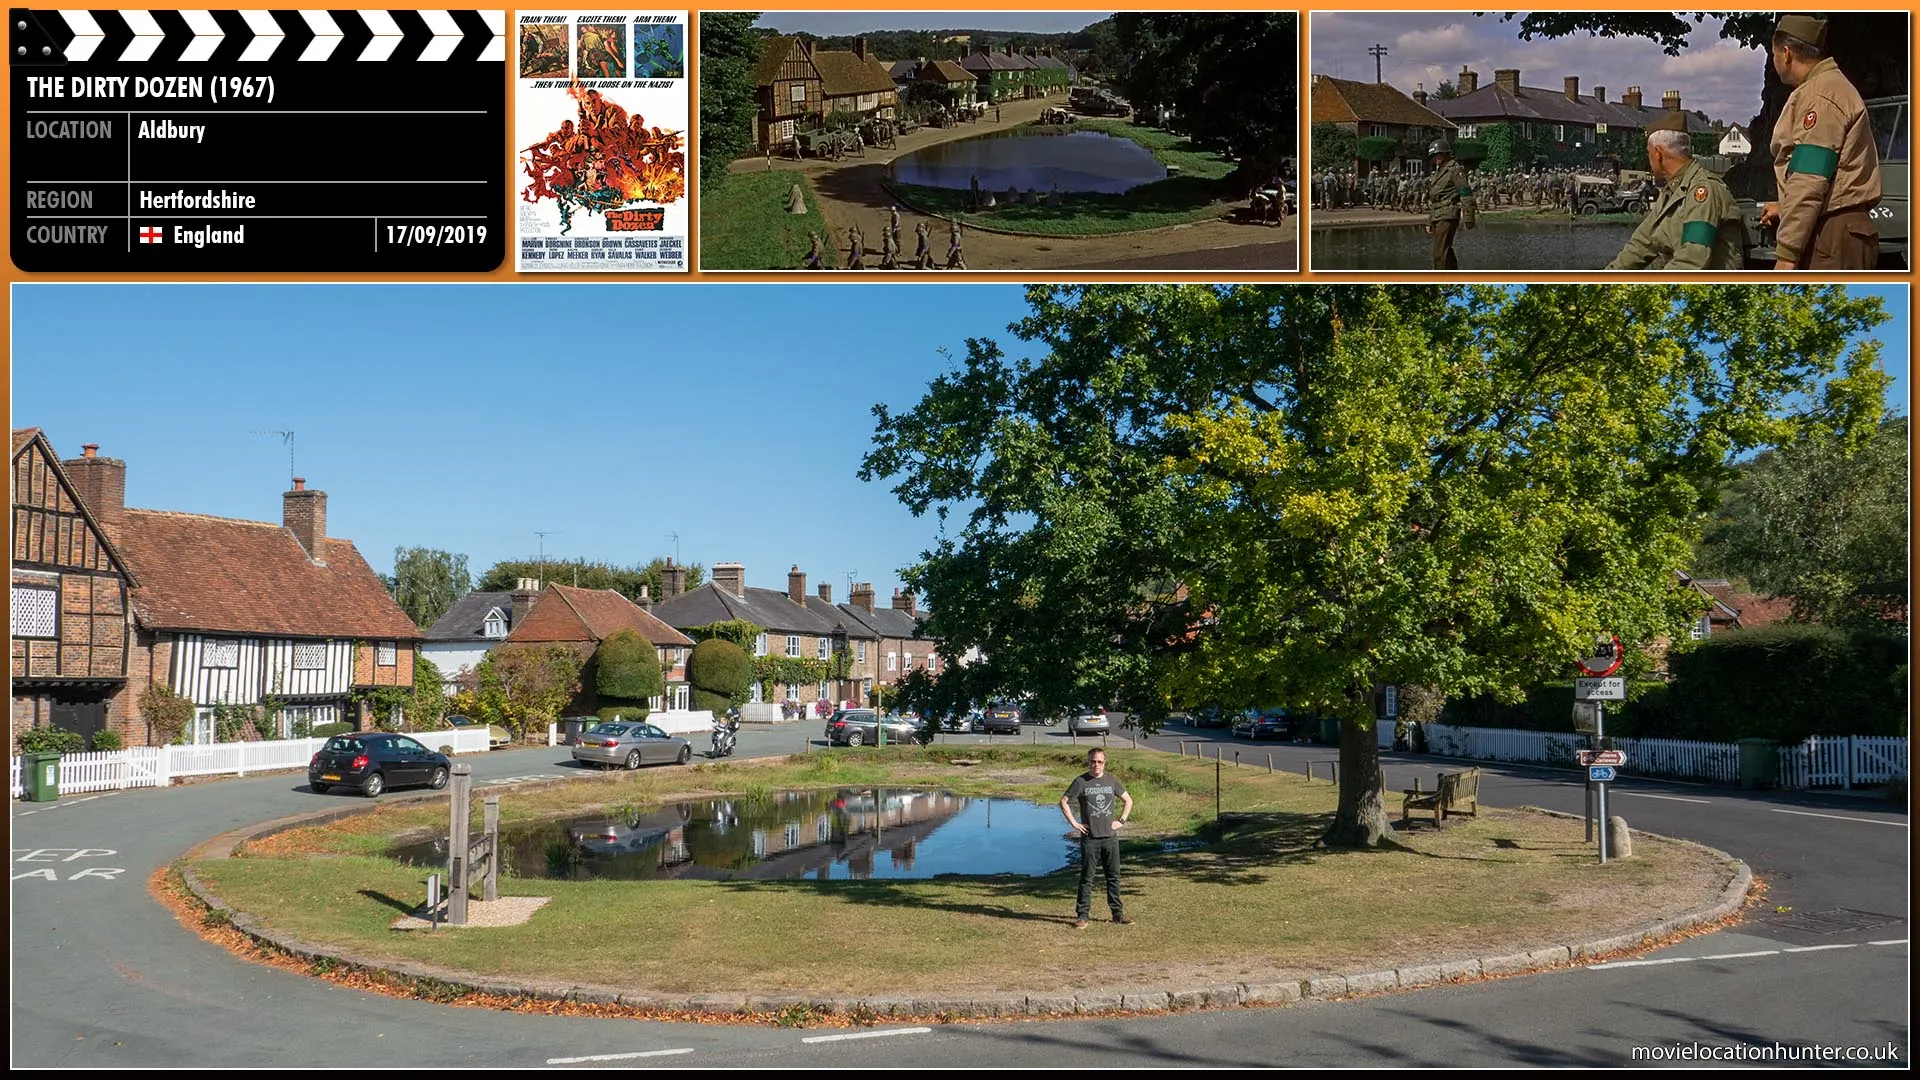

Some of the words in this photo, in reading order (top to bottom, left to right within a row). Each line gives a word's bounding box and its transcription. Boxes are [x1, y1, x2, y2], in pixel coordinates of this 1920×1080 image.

[520, 15, 542, 23] TRAIN
[543, 15, 567, 23] THEM!
[577, 15, 602, 23] EXCITE
[602, 15, 626, 23] THEM!
[633, 15, 651, 23] ARM
[652, 15, 677, 23] THEM!
[553, 80, 573, 88] TURN
[574, 80, 597, 88] THEM
[597, 80, 621, 88] LOOSE
[621, 80, 633, 88] ON
[633, 80, 648, 88] THE
[648, 80, 674, 88] NAZIS!
[623, 210, 663, 224] Dirty
[611, 219, 655, 230] Dozen
[1578, 680, 1607, 689] Except
[1609, 680, 1621, 688] for
[12, 848, 118, 862] EP
[12, 867, 126, 881] AR
